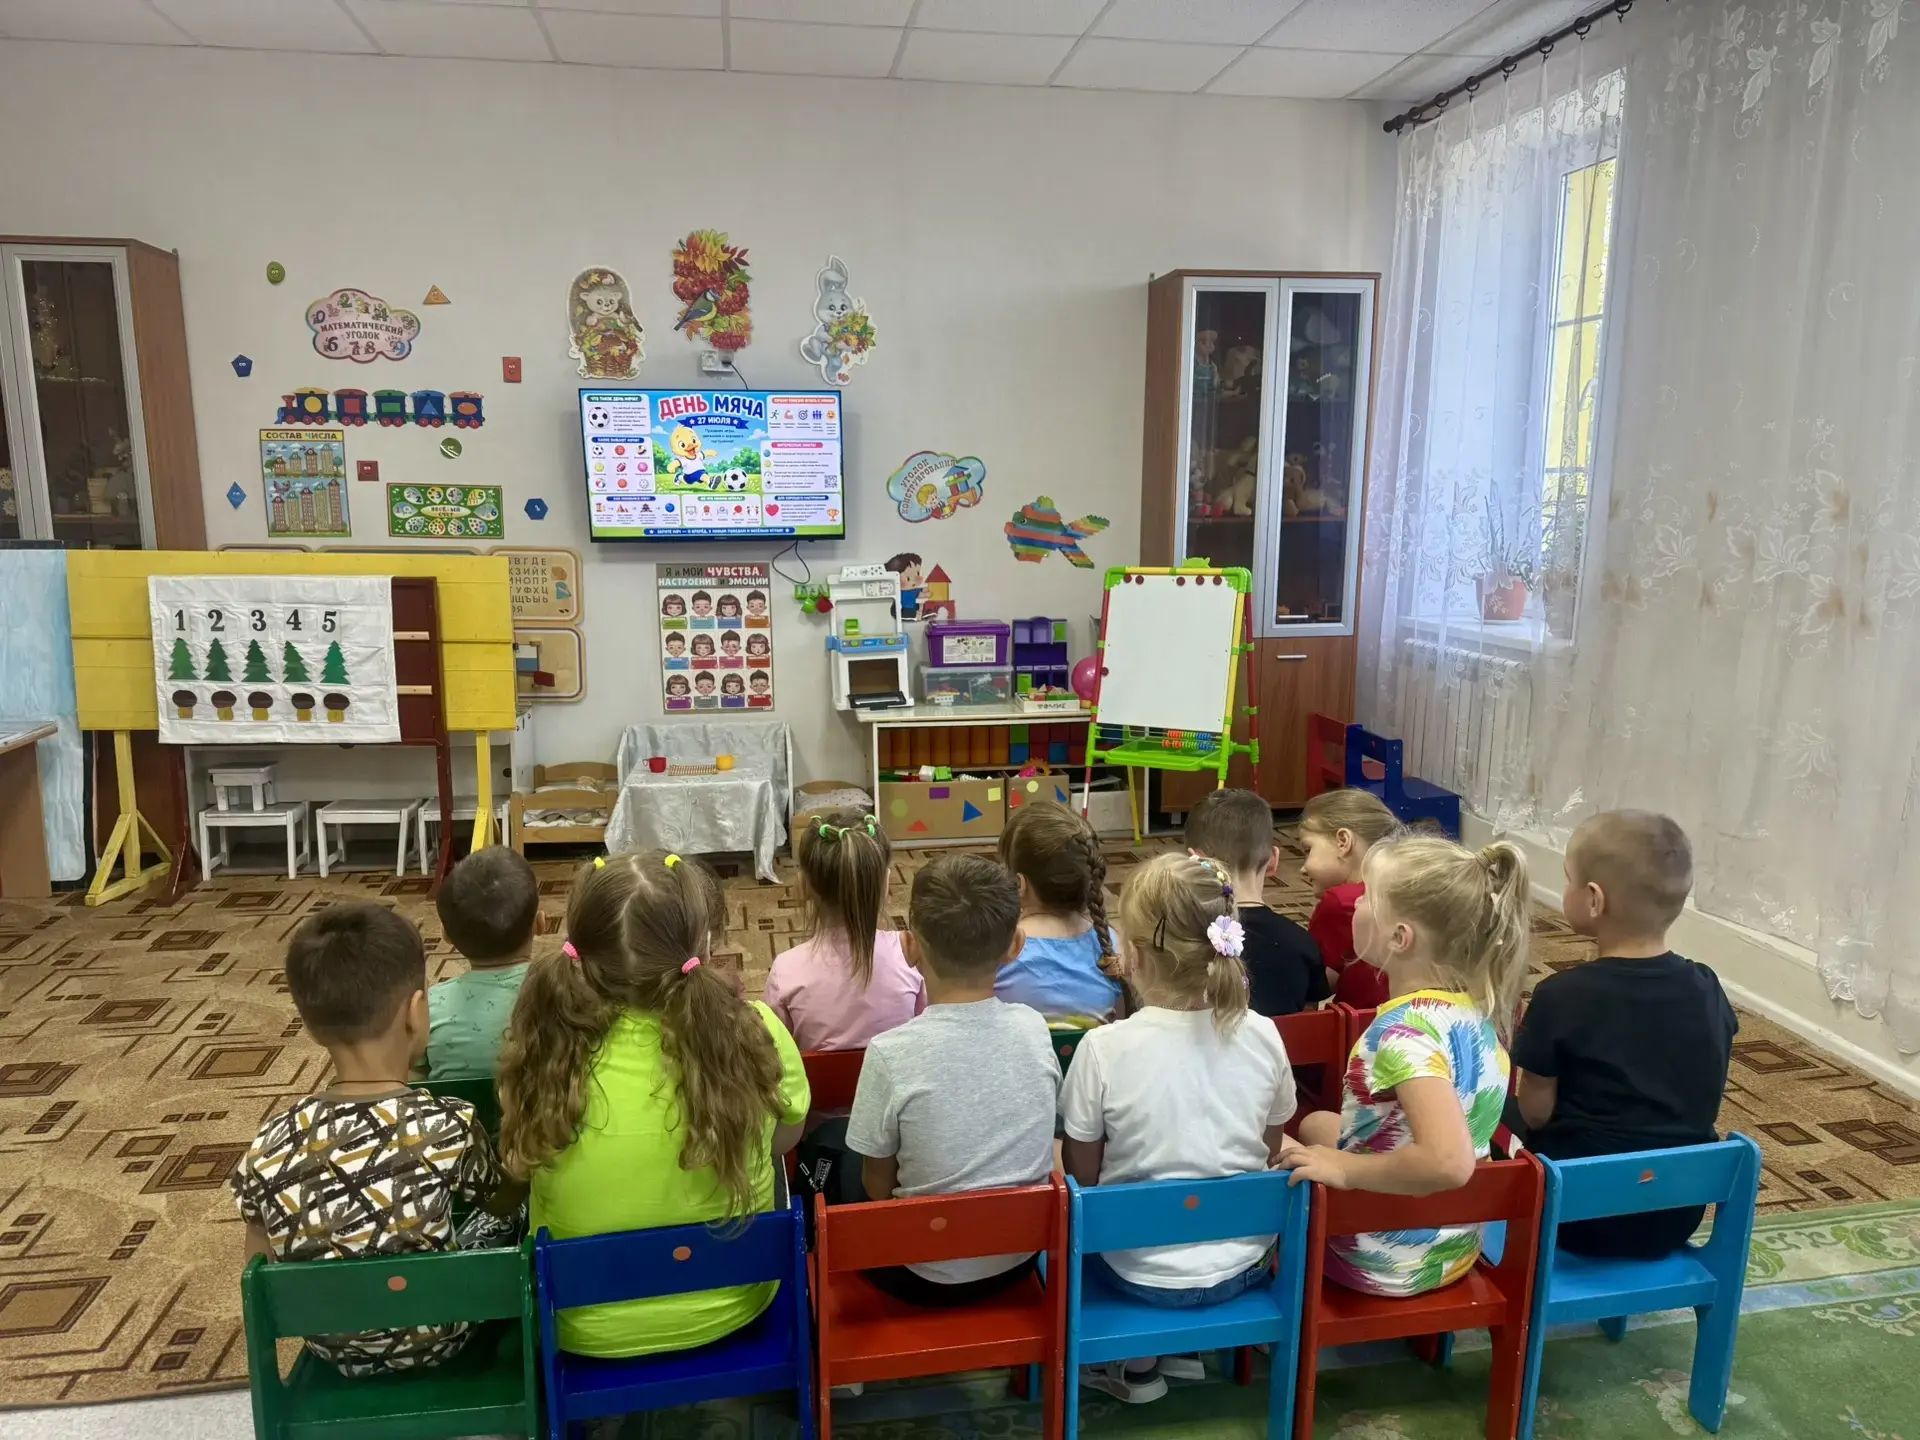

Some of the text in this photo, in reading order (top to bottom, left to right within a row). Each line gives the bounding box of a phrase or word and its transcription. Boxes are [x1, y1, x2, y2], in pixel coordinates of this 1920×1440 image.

[340, 293, 353, 308] 2
[320, 321, 404, 336] МАТЕМАТИЧЕСКИЙ
[345, 331, 380, 340] УГОЛОК
[327, 337, 338, 351] 6
[364, 341, 376, 354] 8
[659, 395, 708, 420] ДЕНЬ
[714, 394, 764, 418] МЯЧА
[900, 458, 930, 488] УГОЛОК
[901, 459, 957, 515] КОНСТРУИРОВАНИЯ
[436, 491, 442, 499] 3
[448, 490, 454, 498] 4
[478, 492, 484, 500] 5
[491, 508, 497, 516] 6
[480, 525, 486, 533] 7
[666, 568, 672, 576] Я
[683, 568, 703, 576] МОИ
[707, 566, 763, 577] ЧУВСТВА,
[658, 578, 717, 586] НАСТРОЕНИЕ
[728, 578, 769, 586] ЭМОЦИИ
[174, 609, 337, 633] 1 2 3 4 5
